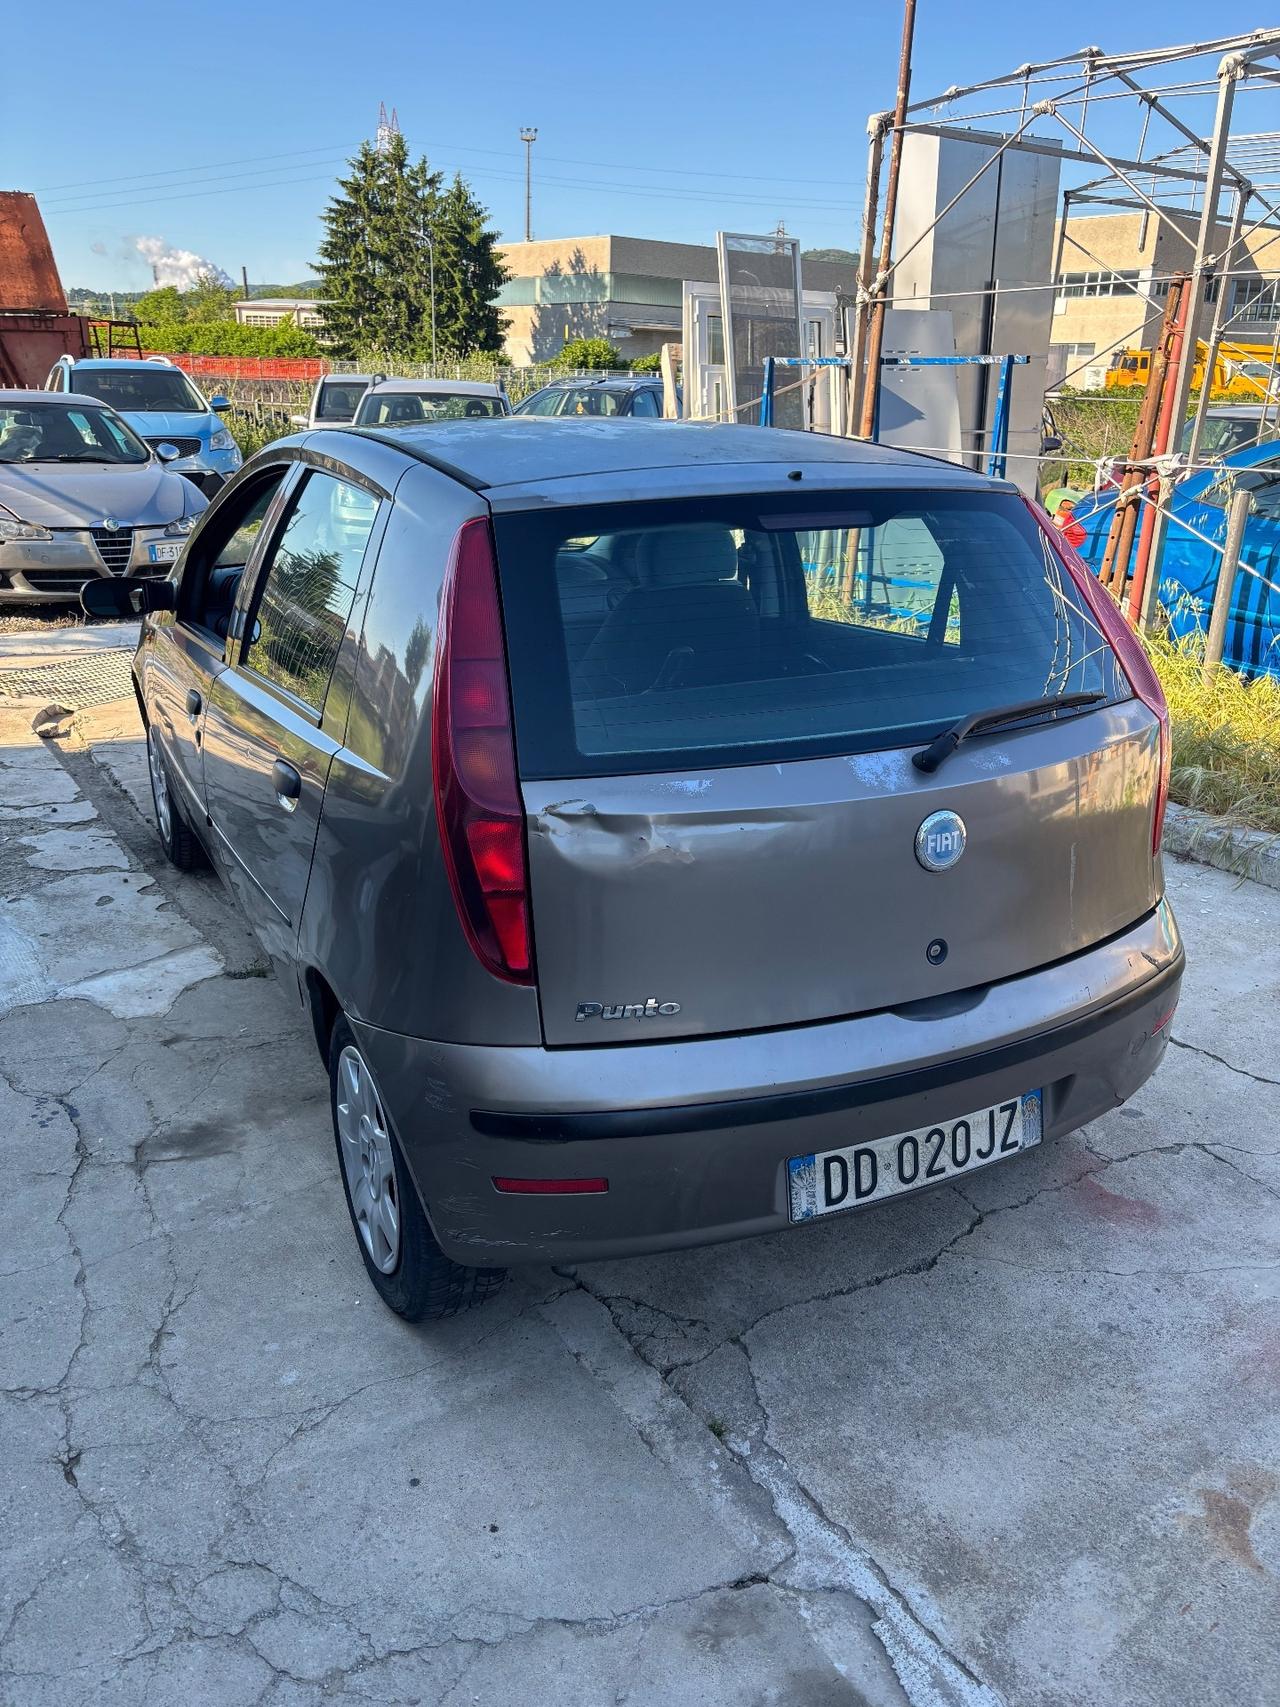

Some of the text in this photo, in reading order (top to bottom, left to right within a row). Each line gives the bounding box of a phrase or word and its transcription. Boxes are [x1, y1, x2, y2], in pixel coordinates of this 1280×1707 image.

[927, 830, 960, 854] FIAT
[575, 998, 681, 1022] Punto
[823, 1100, 1019, 1208] DD 020JZ
